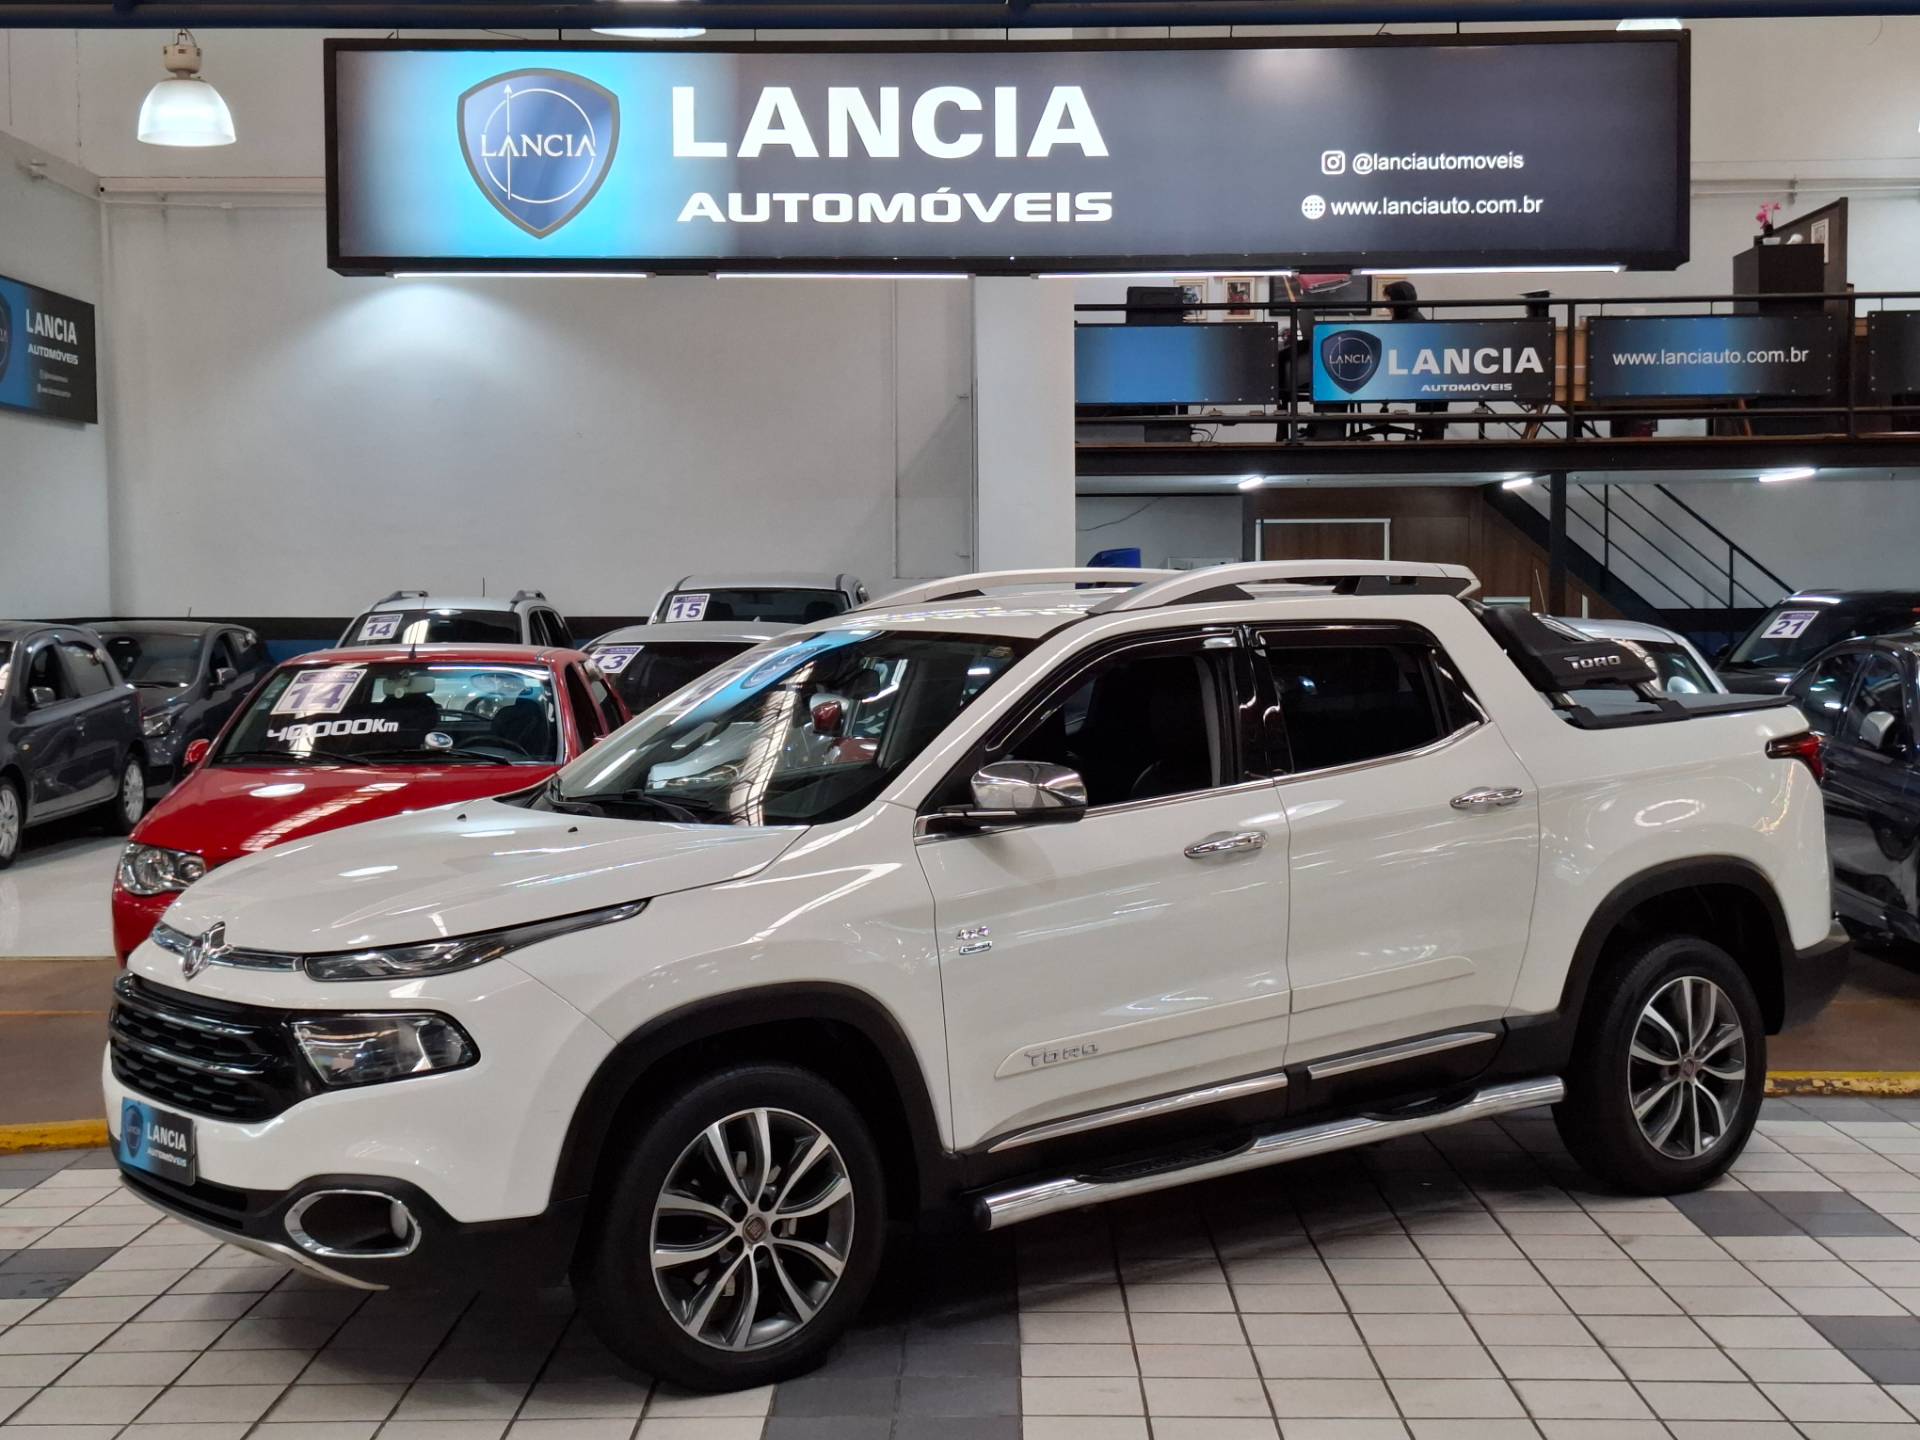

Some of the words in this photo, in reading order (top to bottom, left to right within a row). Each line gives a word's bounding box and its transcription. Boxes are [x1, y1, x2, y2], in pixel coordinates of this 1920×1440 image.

[671, 85, 1109, 159] LANCIA
[480, 133, 597, 158] LANCIA
[1352, 151, 1525, 175] @lanciautomoveis
[677, 187, 1114, 224] AUTOMÓVEIS
[1330, 195, 1544, 217] www.lanciauto.com.br
[26, 309, 77, 345] LANCIA
[28, 343, 79, 365] AUTOMÓVEIS
[1328, 353, 1374, 365] LANCIA
[1388, 347, 1545, 376] LANCIA
[1613, 347, 1809, 367] www.lanciauto.com.br
[1421, 382, 1513, 393] AUTOMÓVEIS
[673, 603, 702, 619] 15
[367, 623, 393, 637] 14
[1770, 621, 1805, 635] 21
[290, 684, 345, 709] 14
[147, 1122, 187, 1151] LANCIA
